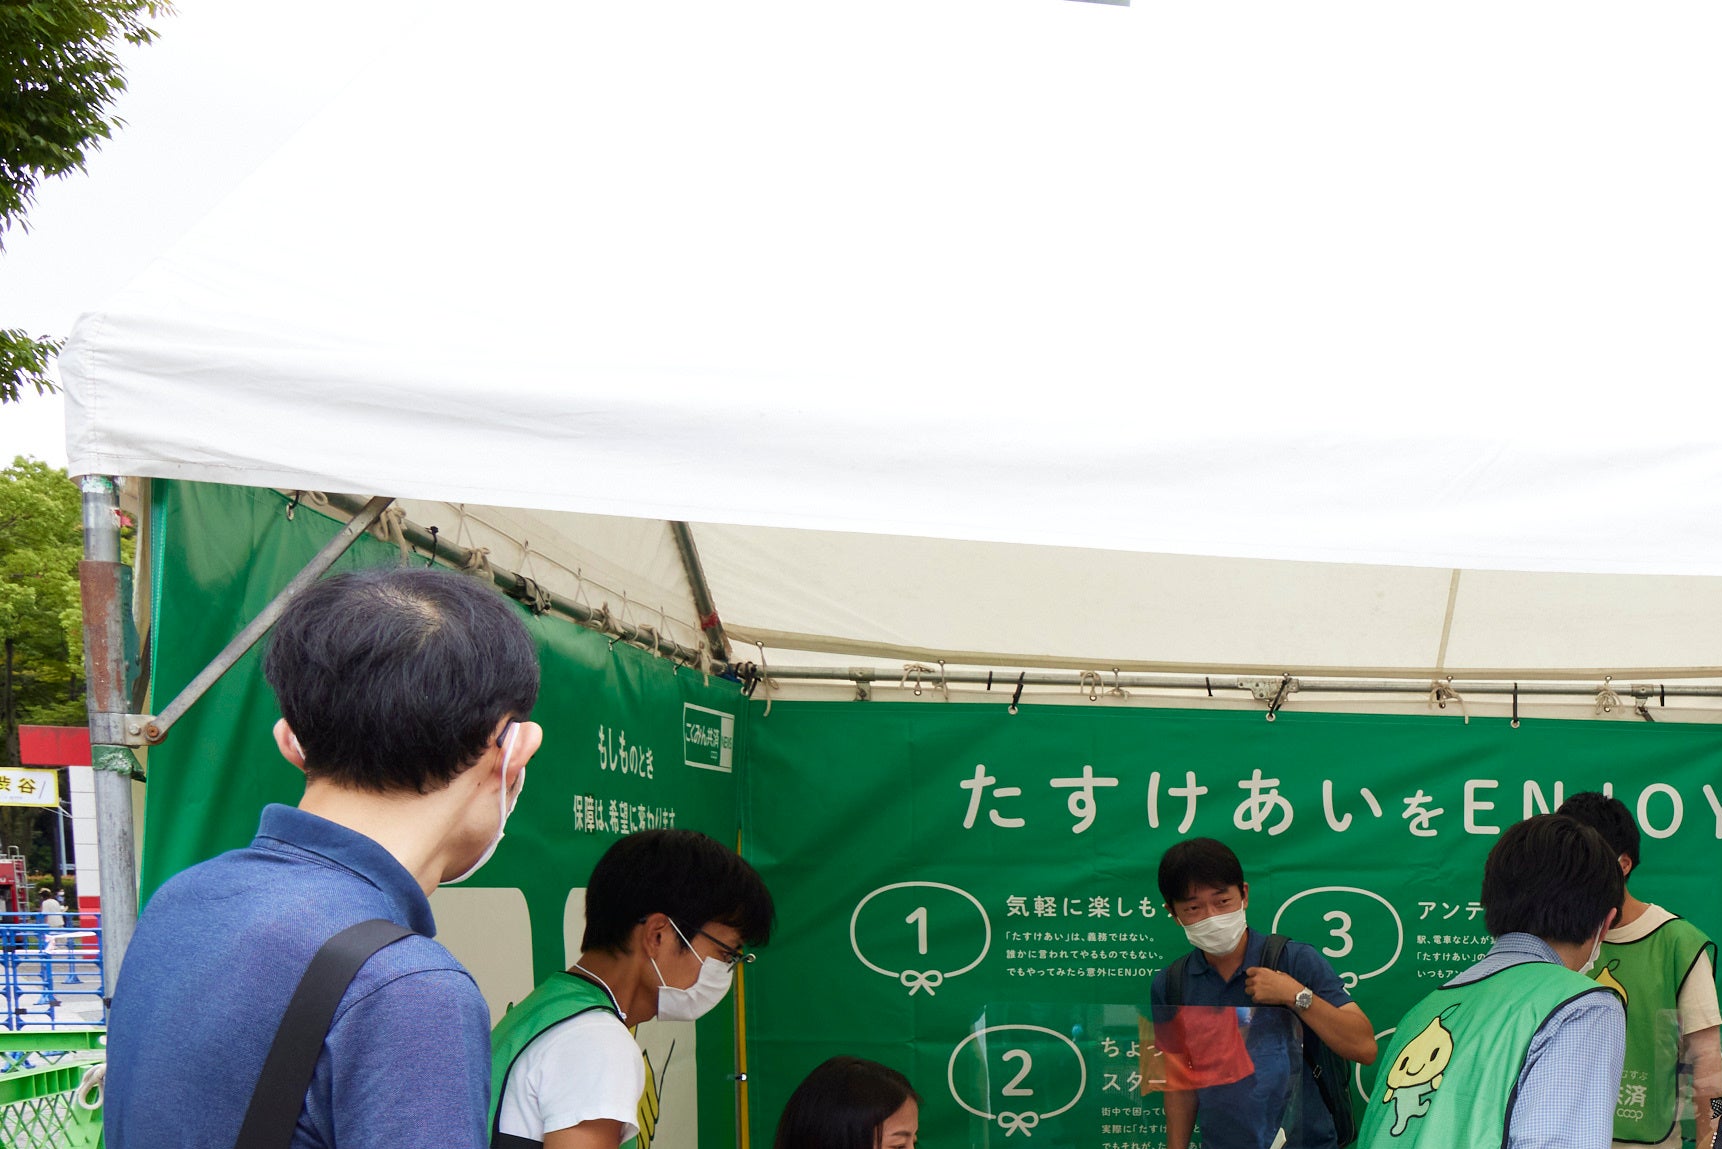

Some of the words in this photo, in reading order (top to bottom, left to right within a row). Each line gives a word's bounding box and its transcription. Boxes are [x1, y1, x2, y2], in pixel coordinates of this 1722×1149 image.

[598, 724, 654, 780] もしものとき
[905, 907, 928, 956] 1
[1005, 931, 1155, 943] 「たすけあい」は、義務ではない。
[1006, 949, 1164, 960] 誰かに言われてやるものでもない。
[1321, 910, 1353, 958] 3
[1001, 1049, 1034, 1096] 2
